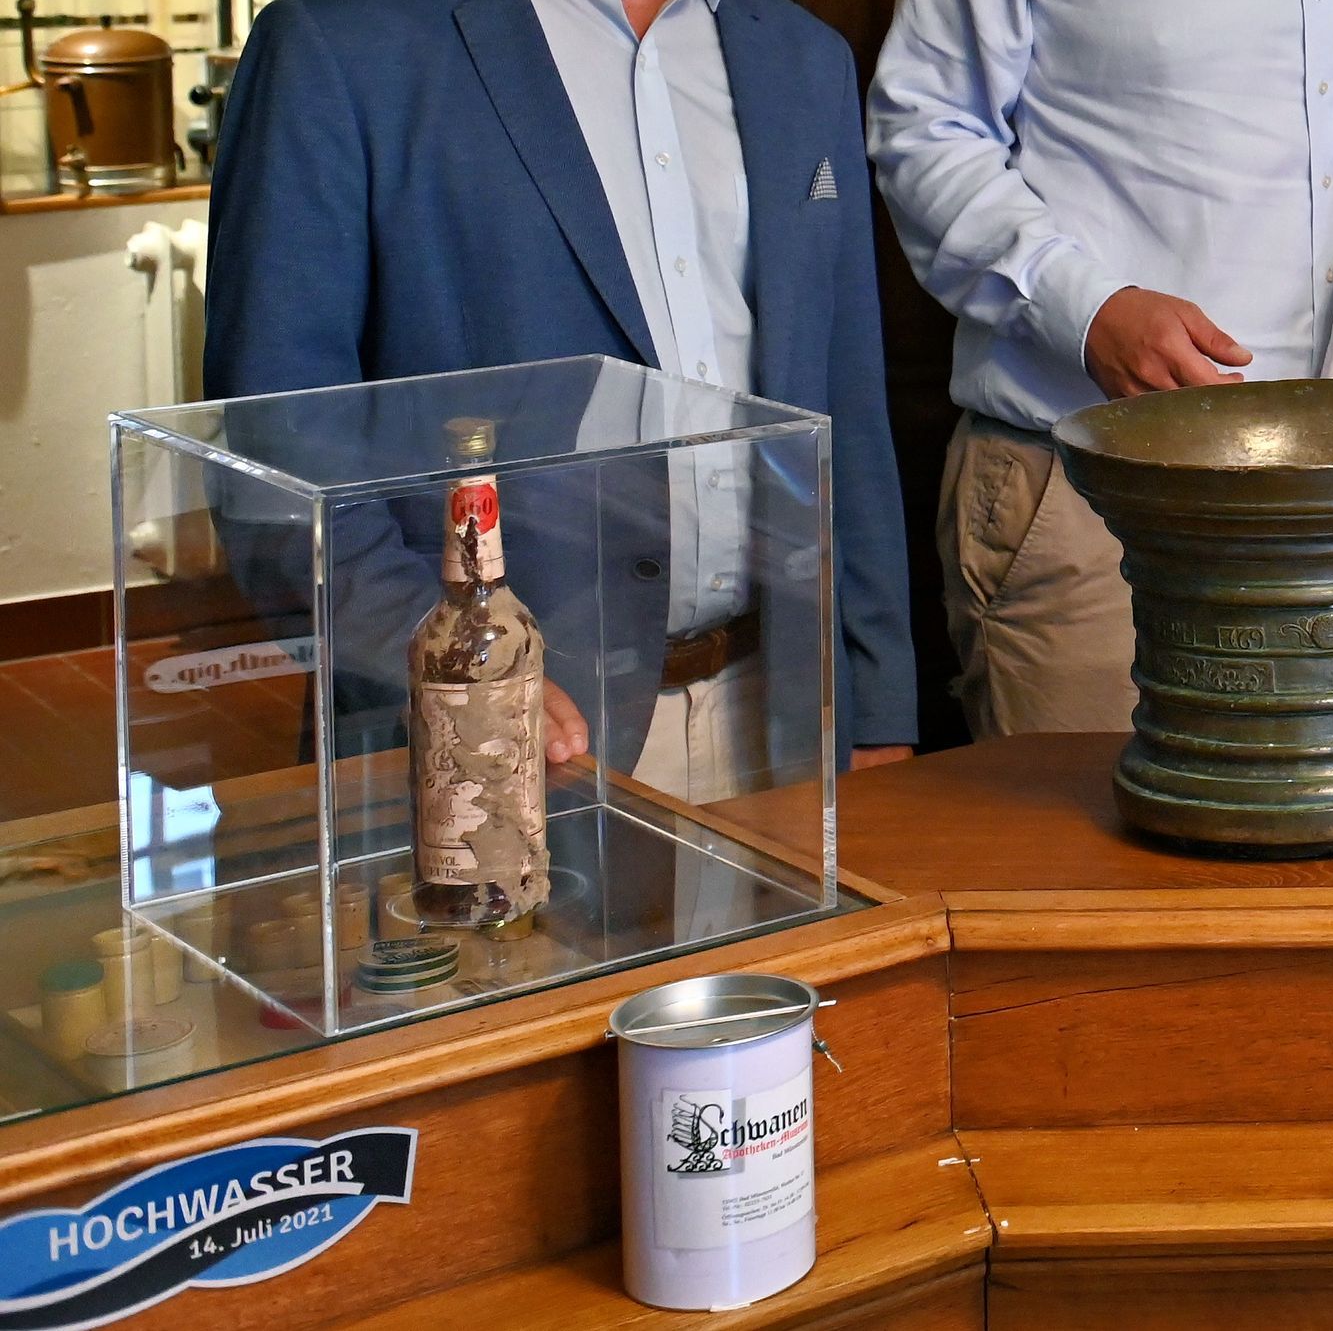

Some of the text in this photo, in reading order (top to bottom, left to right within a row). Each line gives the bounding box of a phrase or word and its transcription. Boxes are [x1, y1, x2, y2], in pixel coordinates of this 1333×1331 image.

[694, 1098, 808, 1154] Schwanen
[49, 1149, 356, 1261] HOCHWASSER
[190, 1203, 336, 1260] 14. Juli 2021
